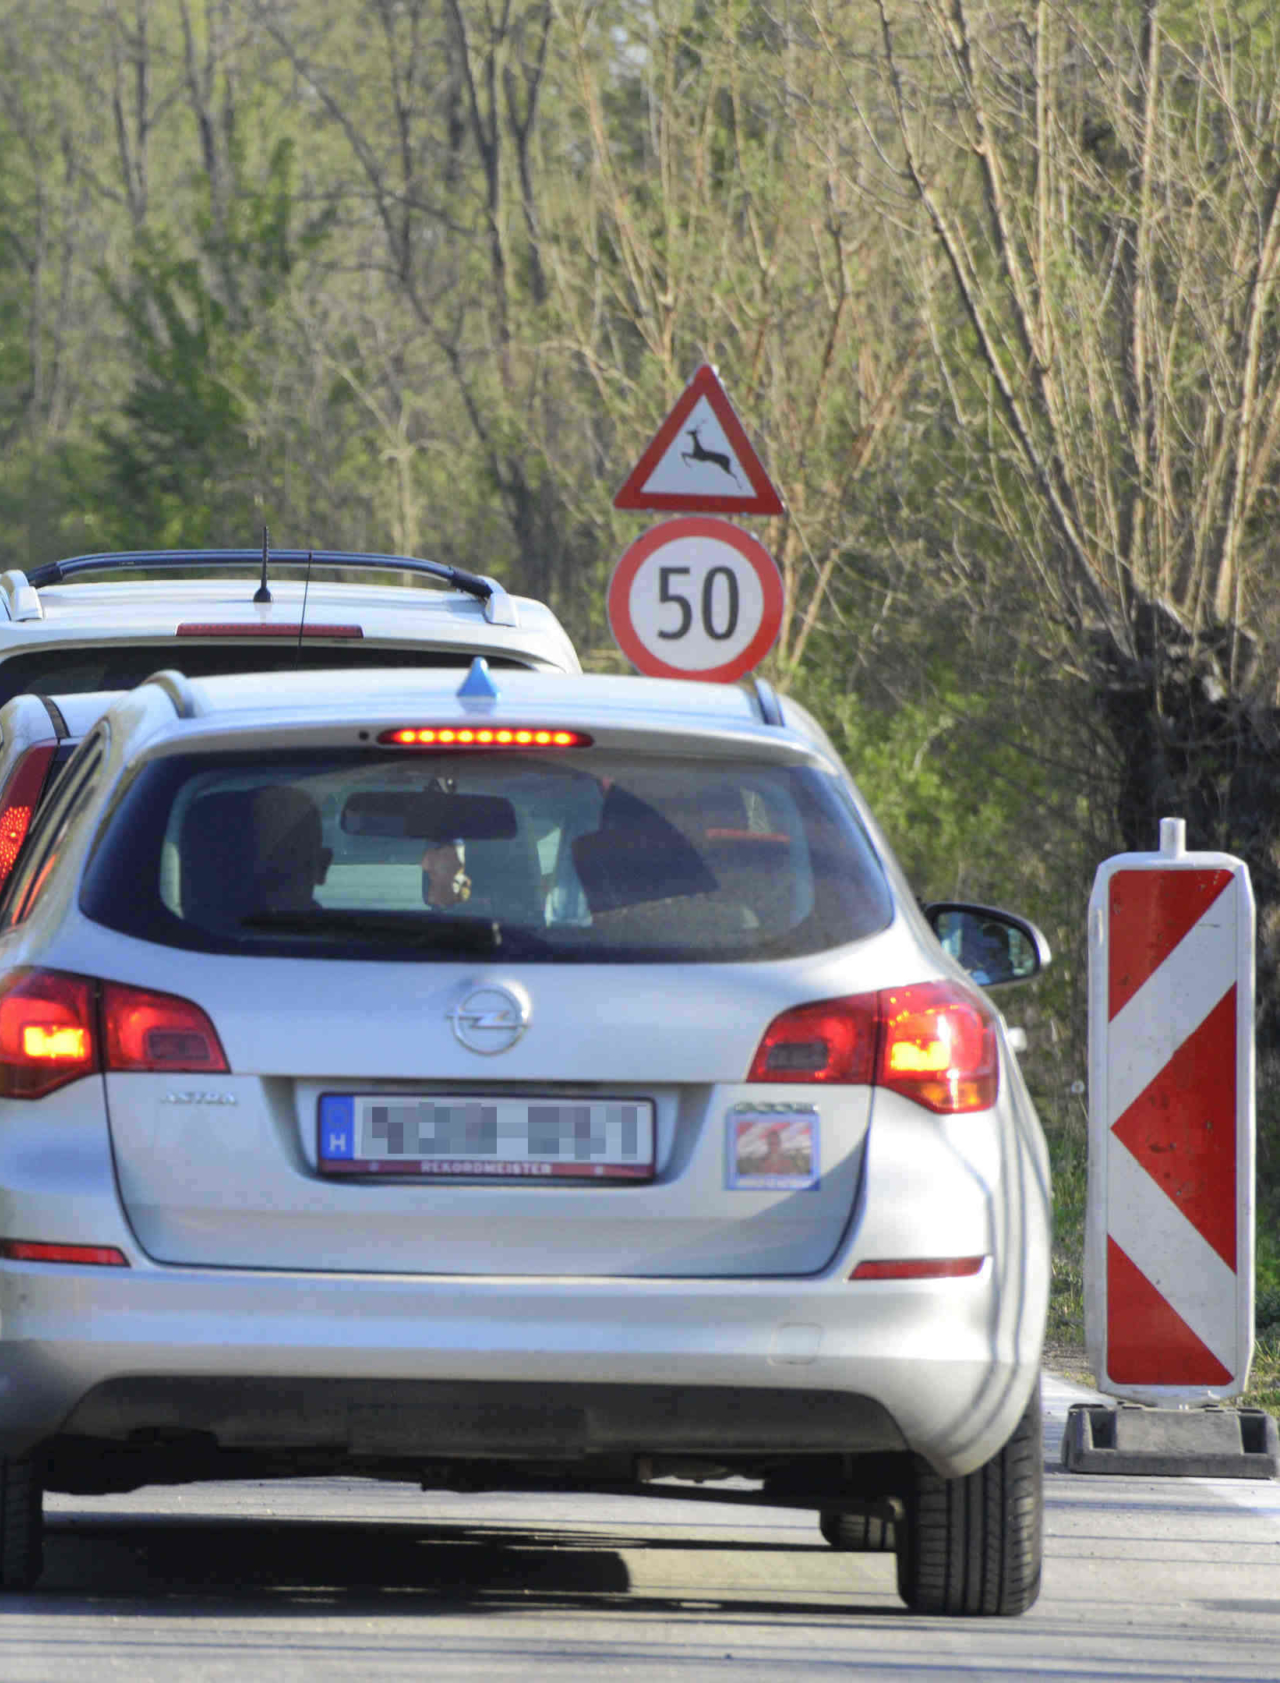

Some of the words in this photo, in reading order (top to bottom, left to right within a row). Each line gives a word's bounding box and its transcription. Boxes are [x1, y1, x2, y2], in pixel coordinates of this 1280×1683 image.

[657, 565, 740, 641] 50
[161, 1090, 238, 1105] ASTRA
[329, 1133, 347, 1153] H
[420, 1160, 552, 1175] REKORDMEISTER
